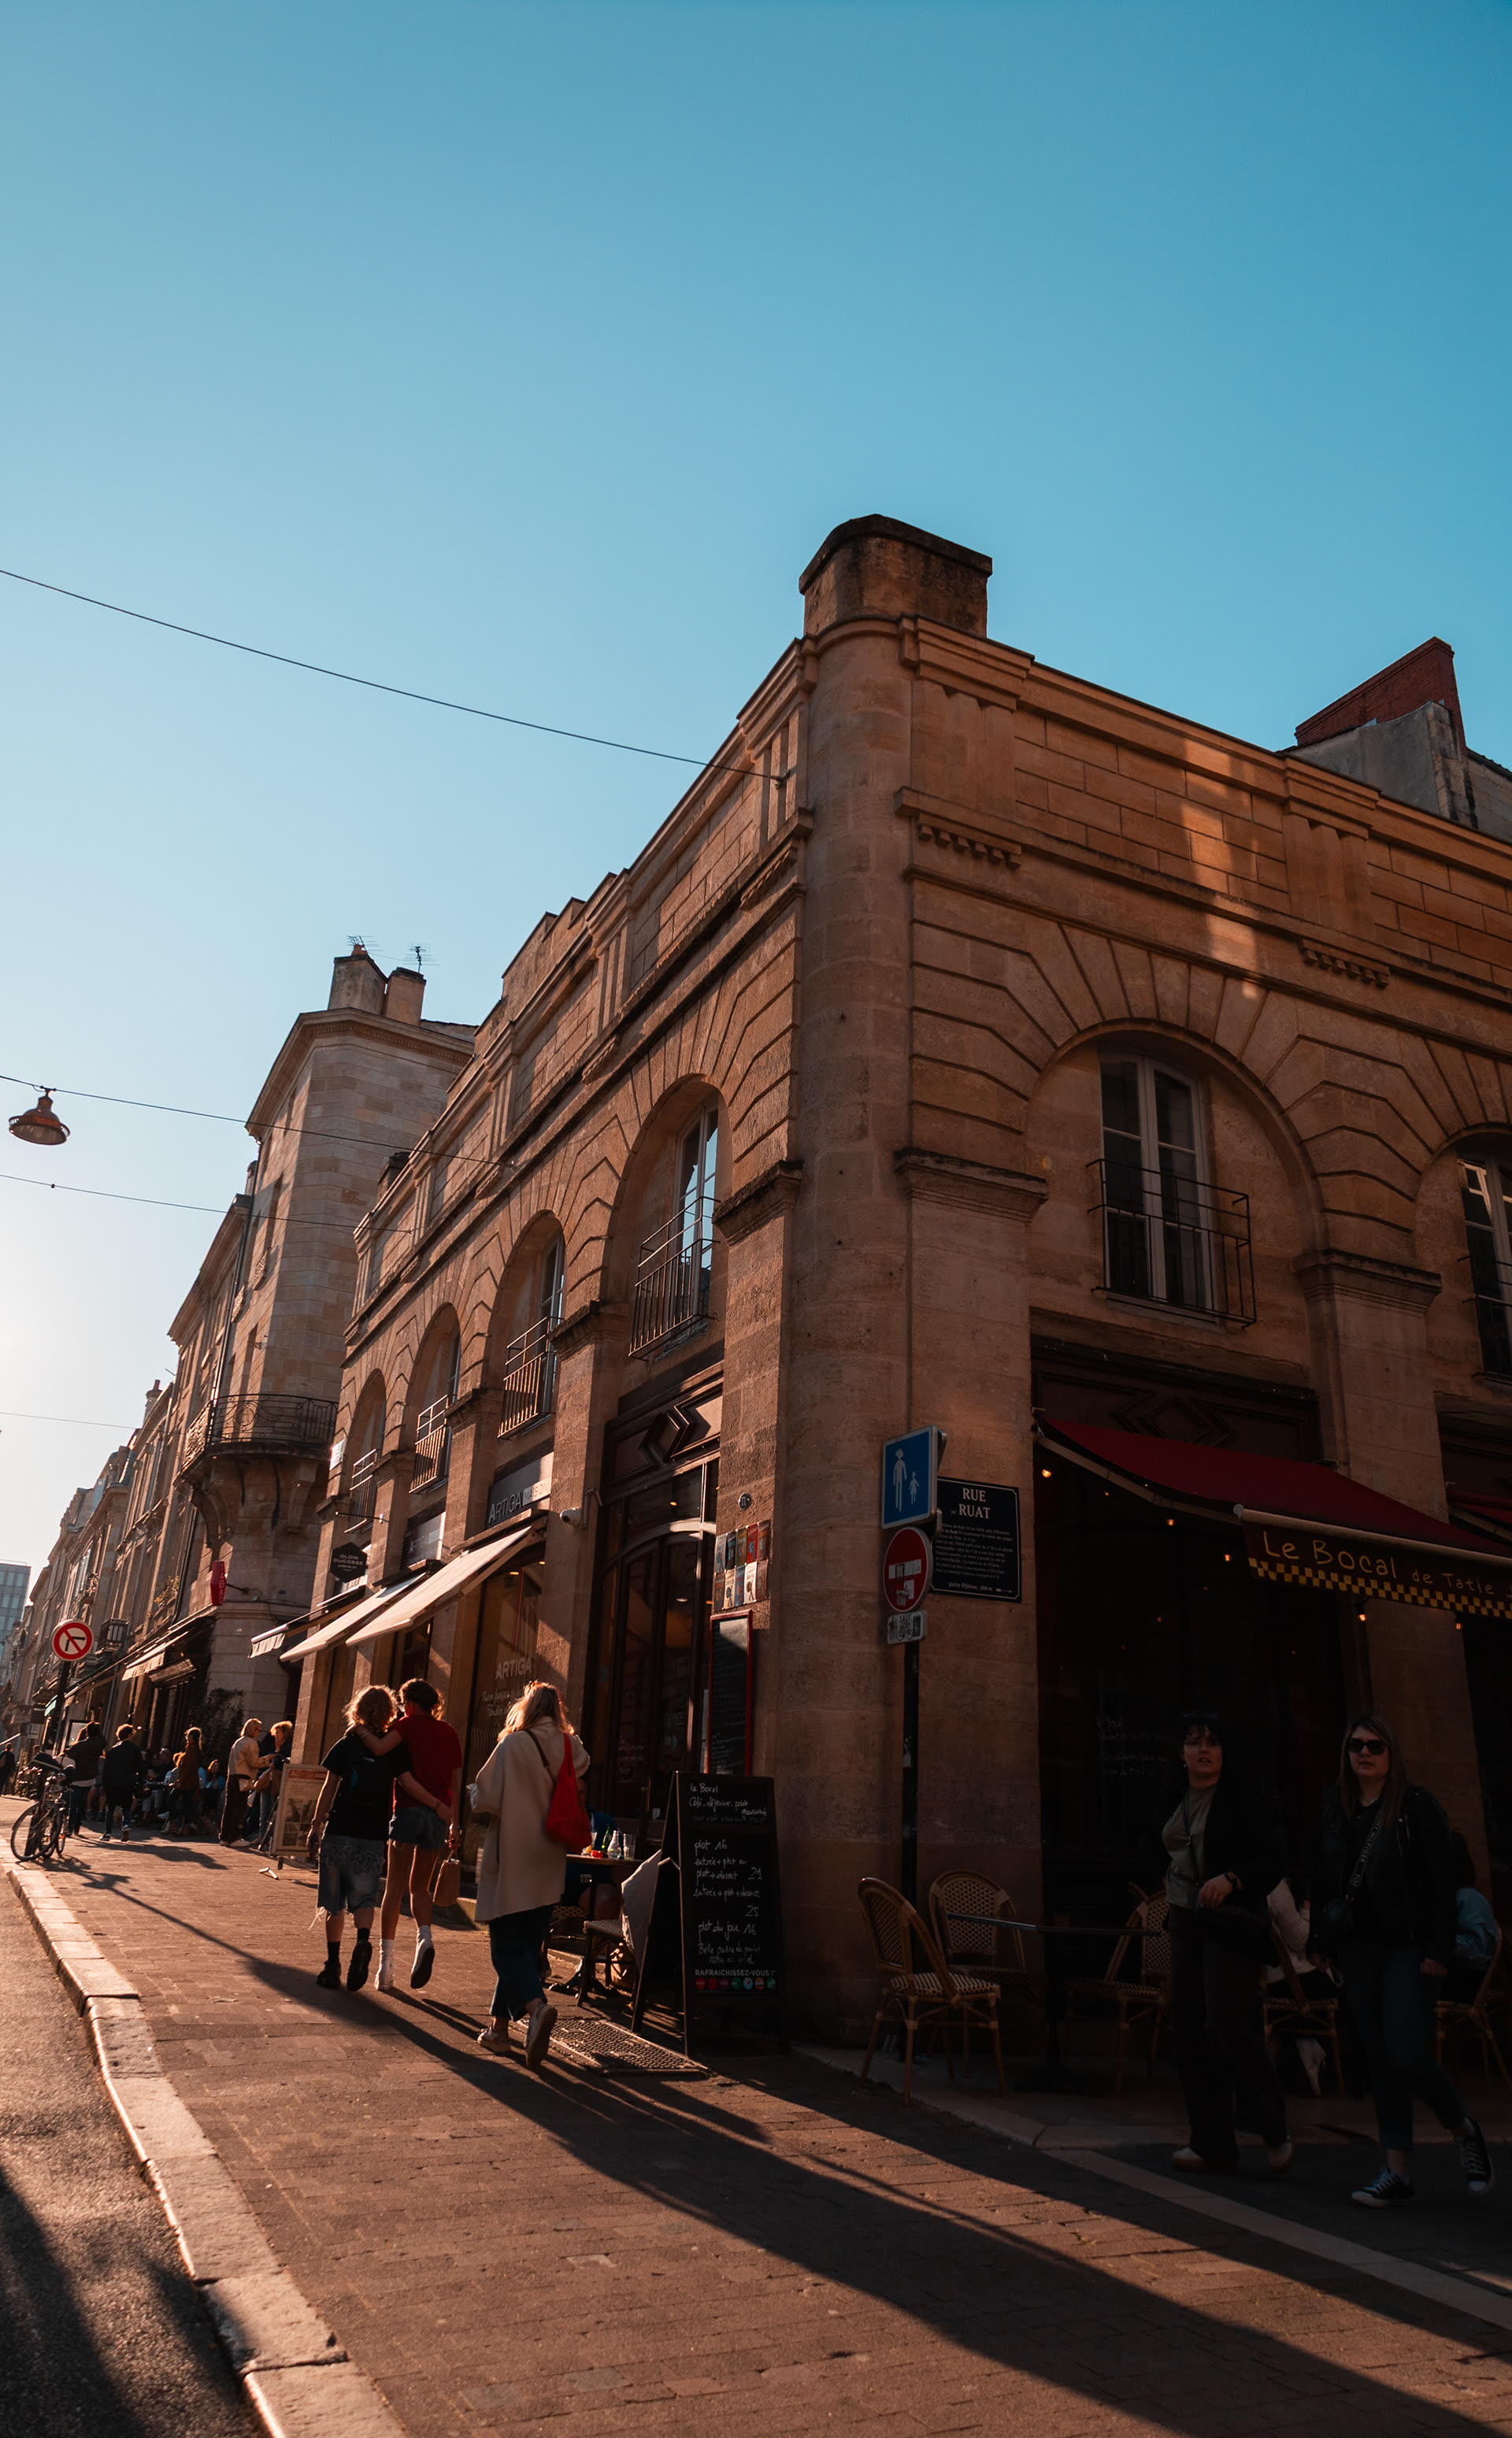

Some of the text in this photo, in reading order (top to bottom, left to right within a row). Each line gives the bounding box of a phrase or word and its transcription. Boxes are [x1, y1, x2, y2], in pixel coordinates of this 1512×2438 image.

[962, 1488, 986, 1502] RUE
[488, 1491, 522, 1523] ARTIGA
[958, 1503, 991, 1519] RUAT
[1263, 1530, 1300, 1560] Le
[1312, 1539, 1398, 1580] Bocal
[1412, 1568, 1434, 1584] de
[1441, 1573, 1495, 1595] Tatie
[899, 1614, 912, 1622] SAUF
[495, 1657, 532, 1680] ARTIGA
[714, 1840, 727, 1851] 16
[747, 1867, 763, 1880] 21
[745, 1905, 759, 1917] 25
[743, 1924, 757, 1936] 16
